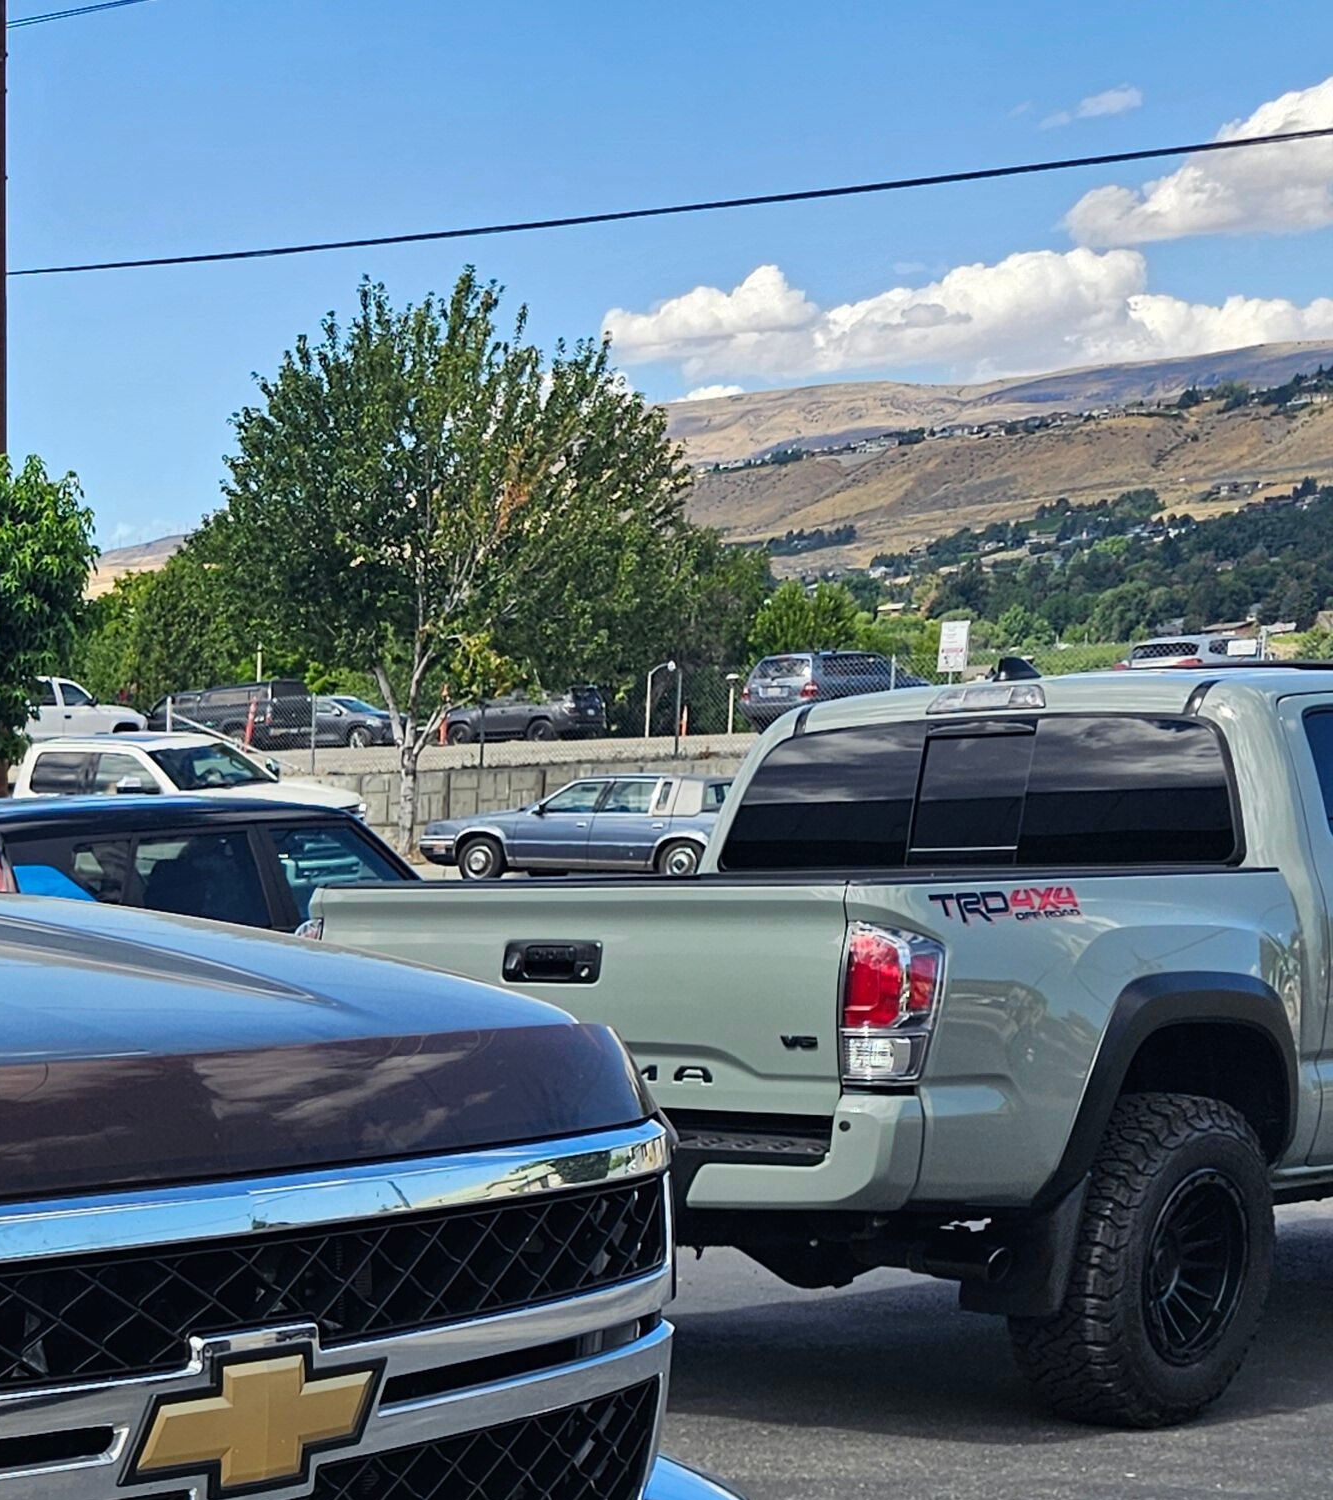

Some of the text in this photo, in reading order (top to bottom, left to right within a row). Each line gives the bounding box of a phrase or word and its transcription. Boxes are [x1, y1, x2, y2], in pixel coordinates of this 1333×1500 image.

[928, 891, 1013, 925] TRD
[1015, 908, 1081, 921] OFF ROAD
[780, 1034, 819, 1051] V6
